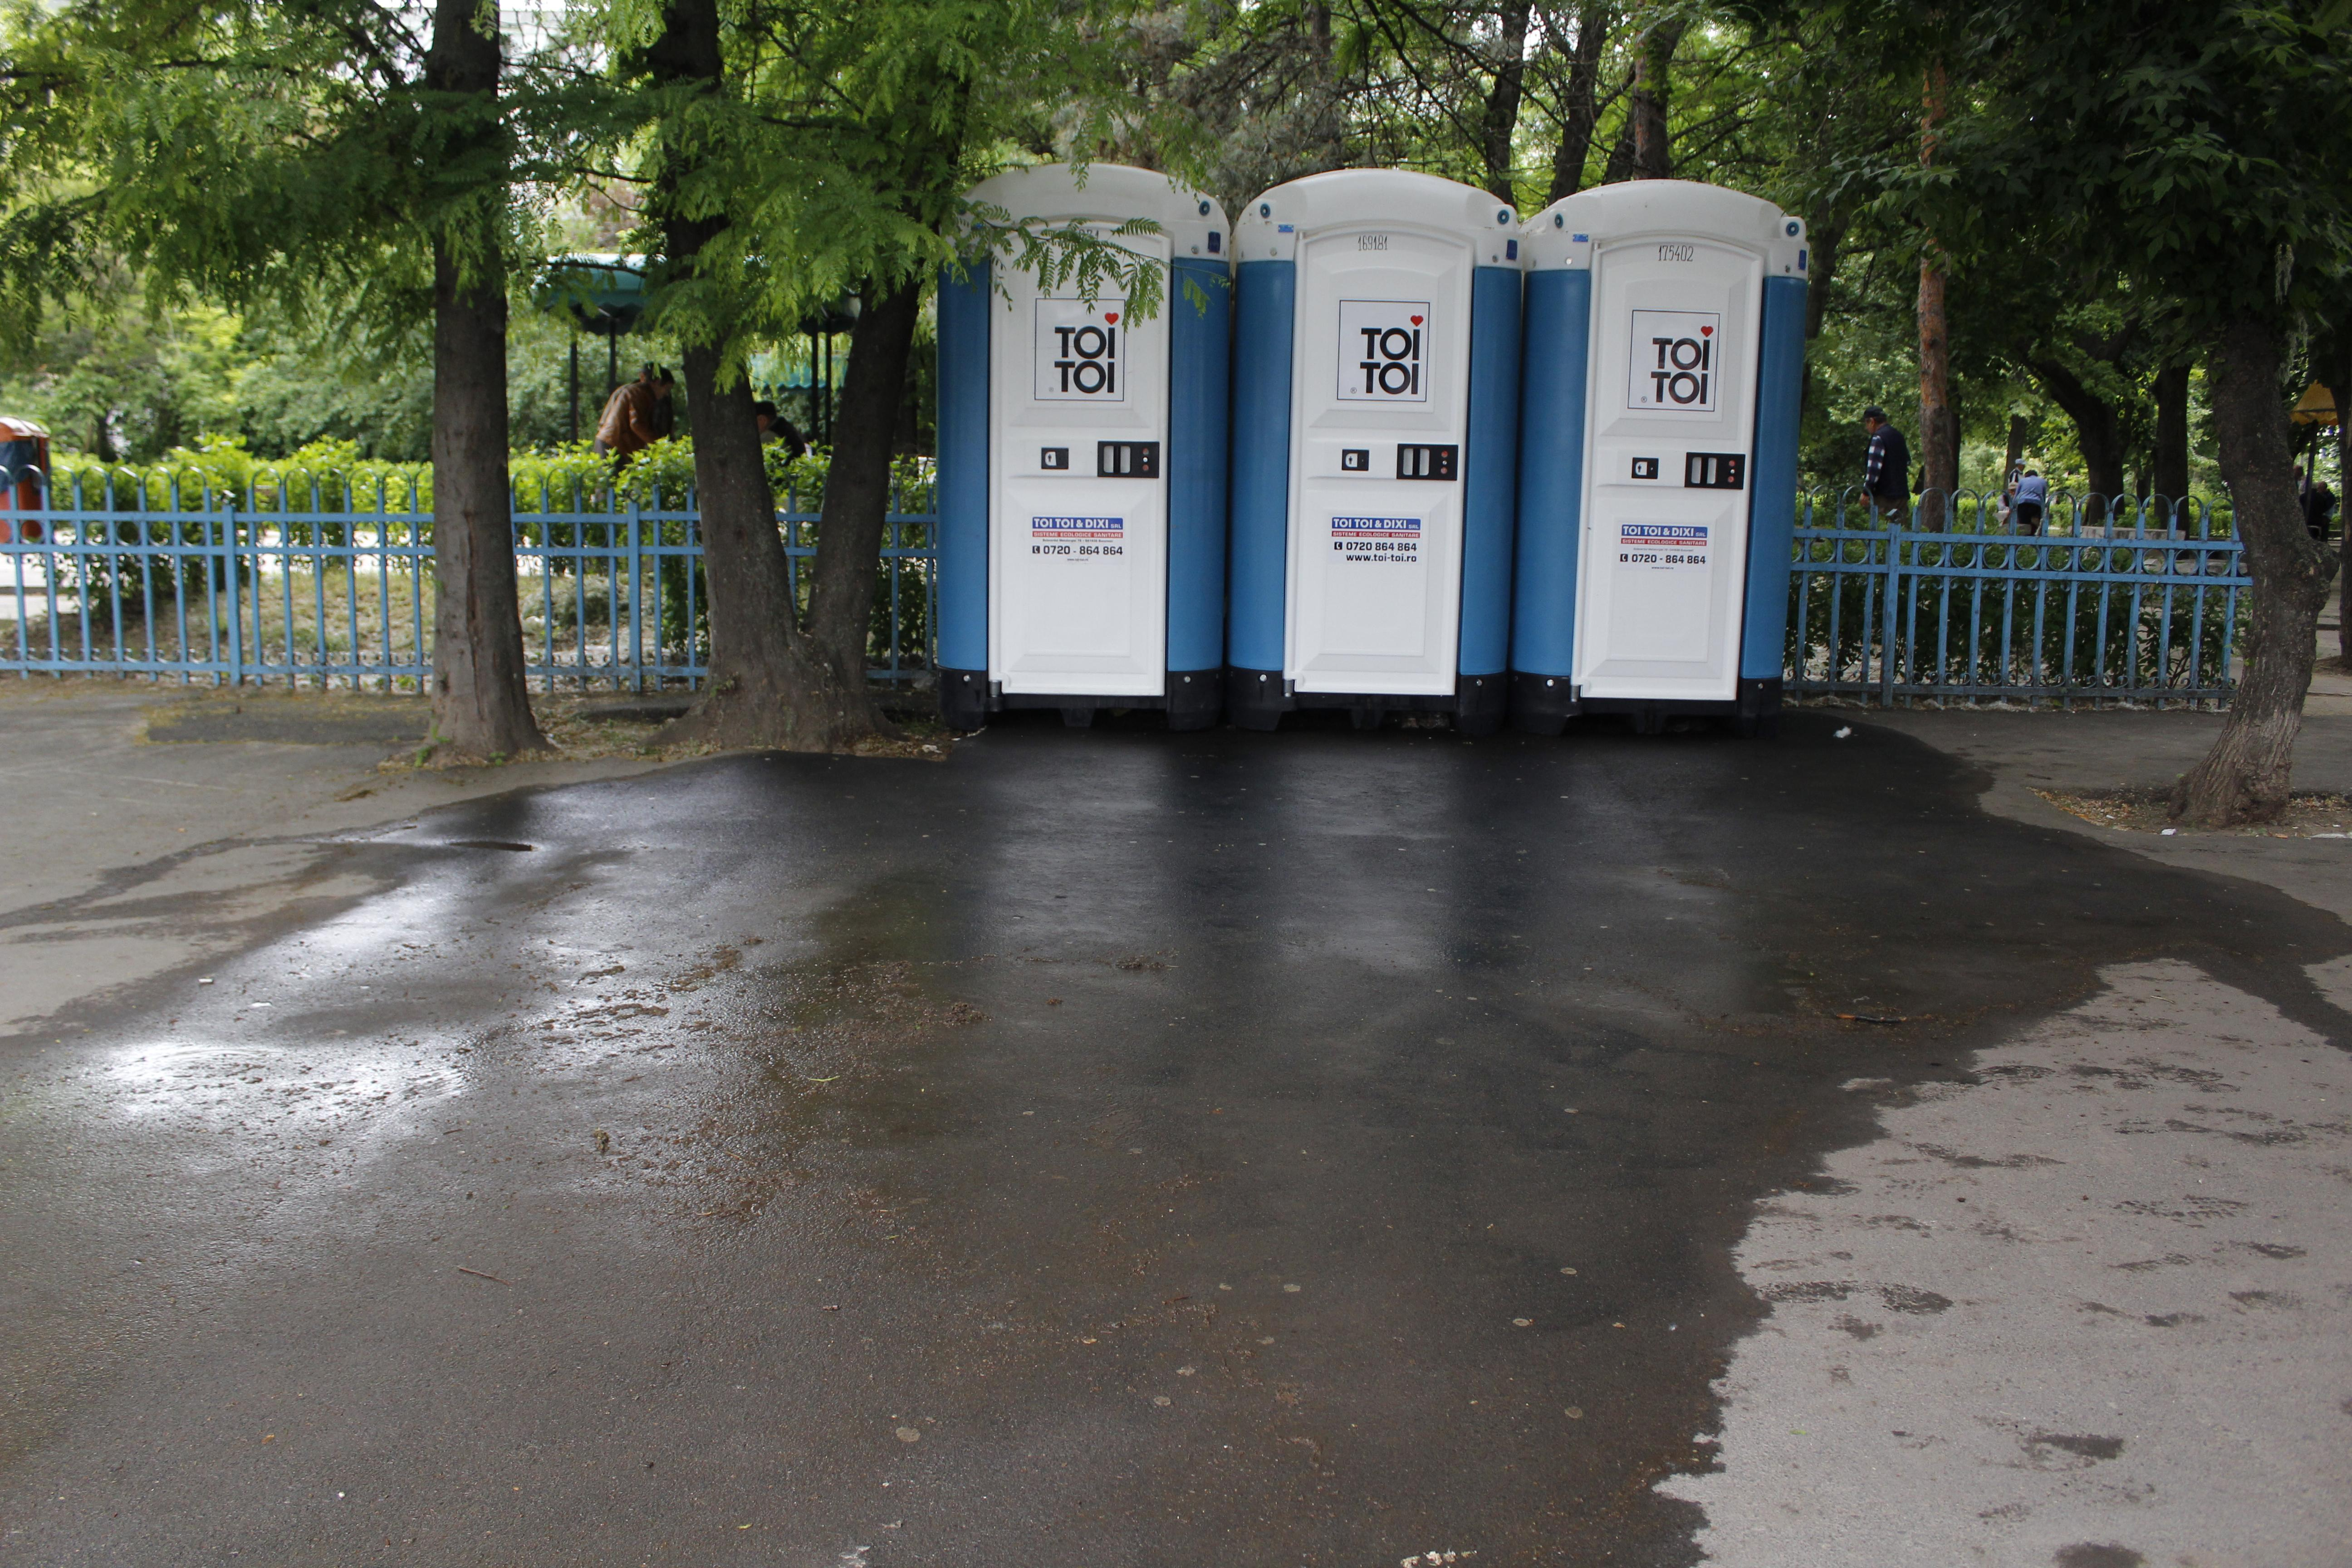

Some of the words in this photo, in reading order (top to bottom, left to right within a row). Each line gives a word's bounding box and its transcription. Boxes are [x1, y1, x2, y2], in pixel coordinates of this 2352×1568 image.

[1659, 245, 1694, 261] 175402
[1054, 360, 1114, 393] TOI
[1360, 362, 1419, 394] TOI
[1651, 371, 1708, 404] TOI
[1034, 519, 1052, 528] TOI
[1055, 519, 1073, 528] TOI
[1076, 519, 1083, 528] &
[1086, 519, 1108, 528] DIXI
[1333, 519, 1351, 528] TOI
[1354, 519, 1372, 528] TOI
[1375, 520, 1382, 528] &
[1384, 520, 1406, 529] DIXI
[1623, 526, 1641, 535] TOI
[1644, 527, 1661, 535] TOI
[1663, 527, 1670, 535] &
[1672, 527, 1694, 536] DIXI
[1044, 545, 1070, 554] 0720
[1080, 546, 1099, 554] 864
[1103, 546, 1122, 555] 864
[1346, 542, 1372, 550] 0720
[1375, 543, 1394, 551] 864
[1397, 543, 1416, 551] 864
[1346, 553, 1416, 562] www.toi-toi.ro
[1632, 554, 1656, 563] 0720
[1666, 555, 1684, 563] 864
[1687, 555, 1705, 564] 864
